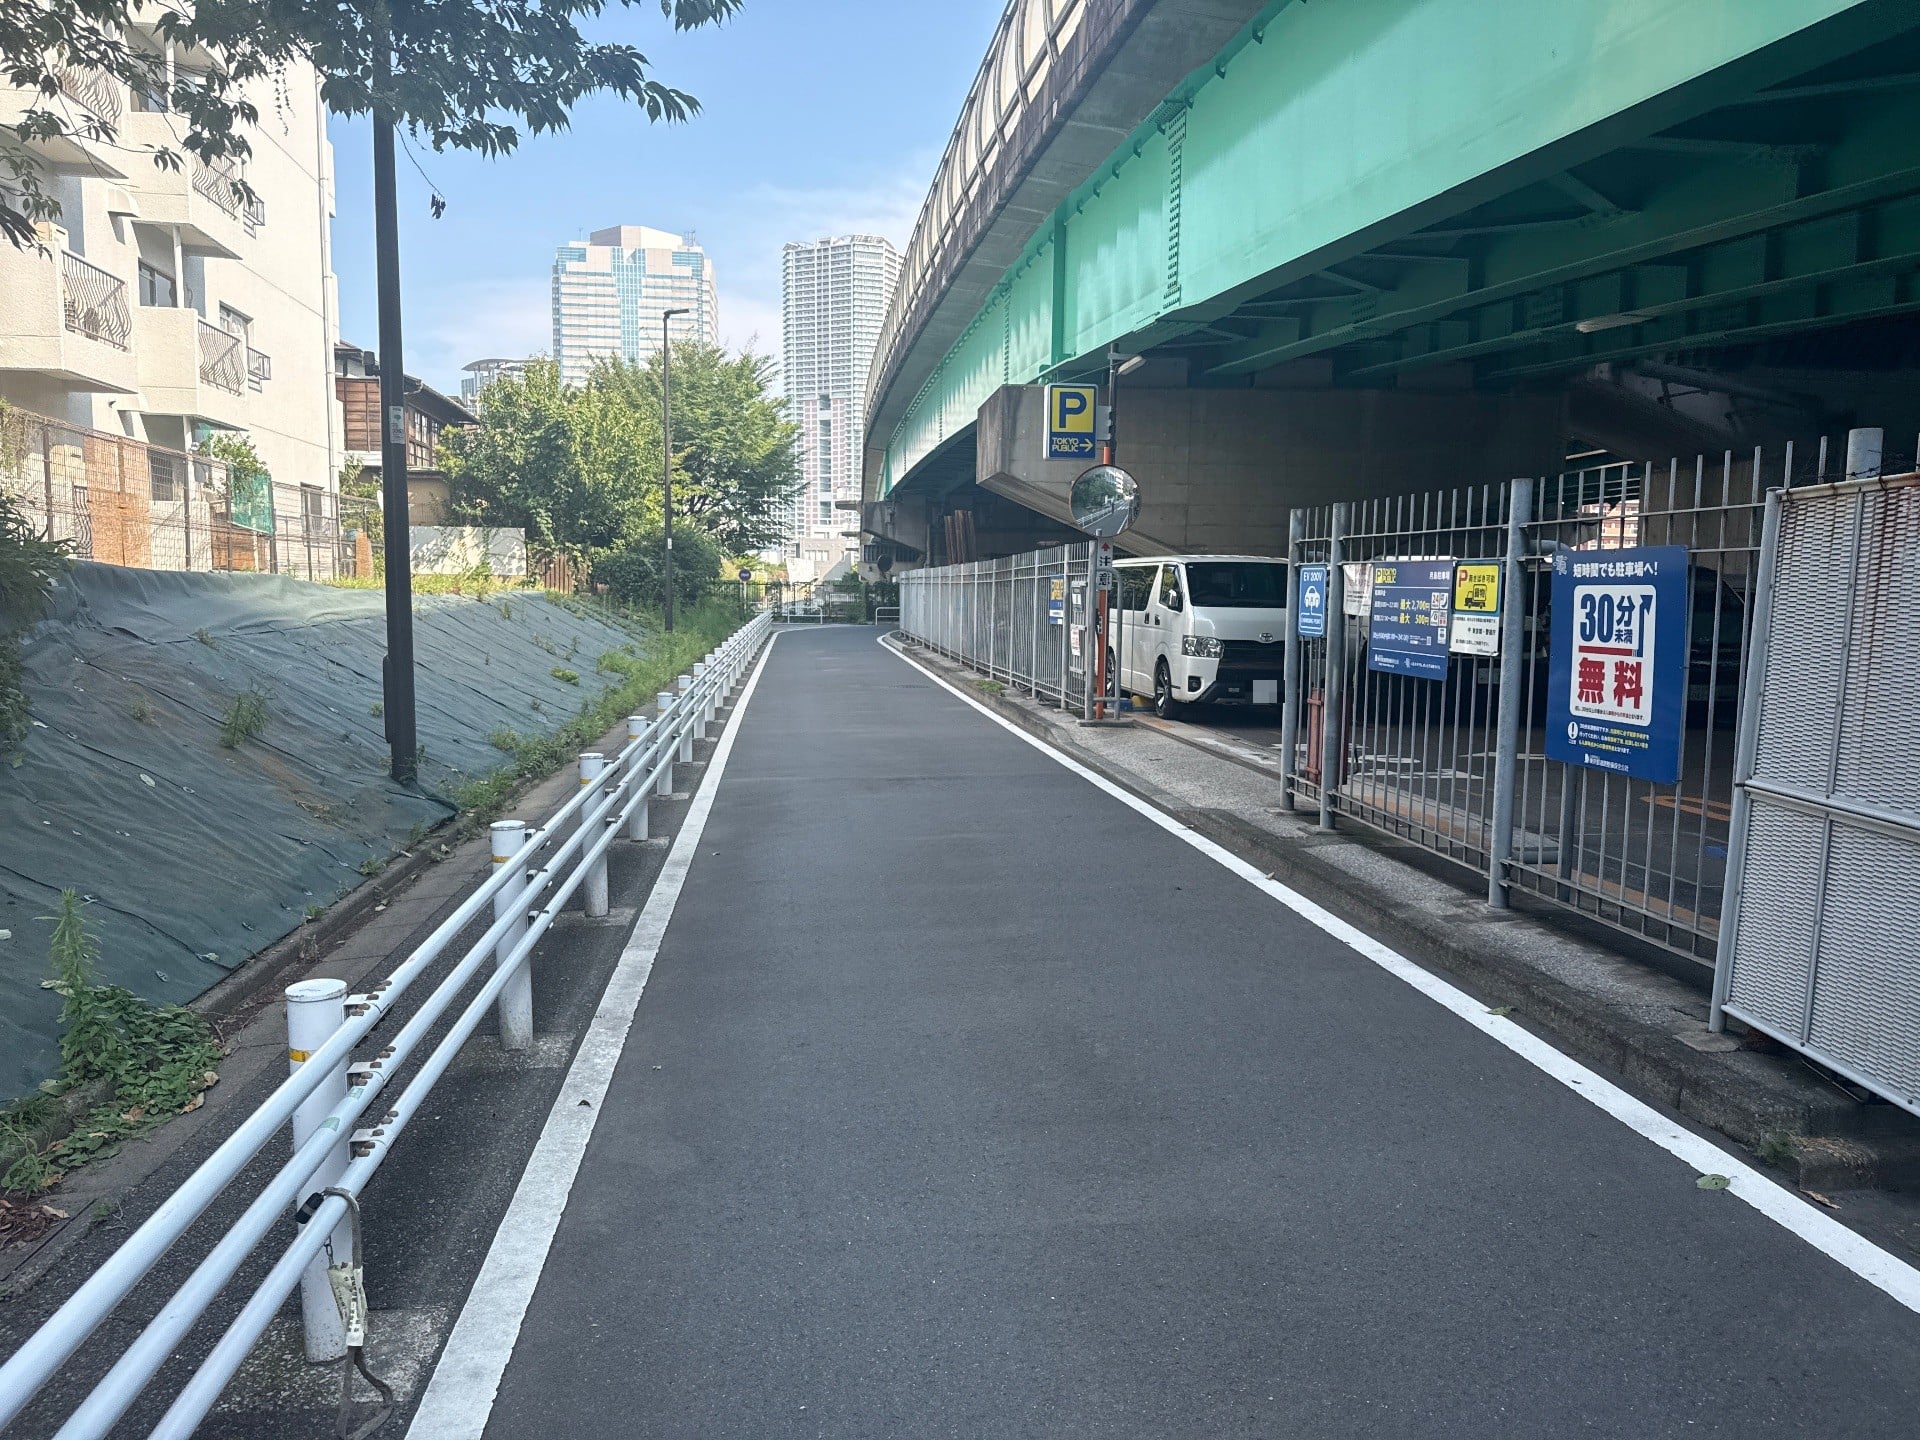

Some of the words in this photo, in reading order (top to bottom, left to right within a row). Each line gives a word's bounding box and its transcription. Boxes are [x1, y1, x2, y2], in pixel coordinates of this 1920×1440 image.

[1059, 391, 1087, 429] P
[1052, 437, 1079, 445] TOKYO
[1099, 555, 1111, 586] 注意
[1303, 571, 1310, 582] EV
[1310, 571, 1323, 582] 200V
[1458, 569, 1469, 588] P
[1573, 561, 1658, 578] 短時間でも駐車場へ!
[1577, 657, 1643, 709] 無料
